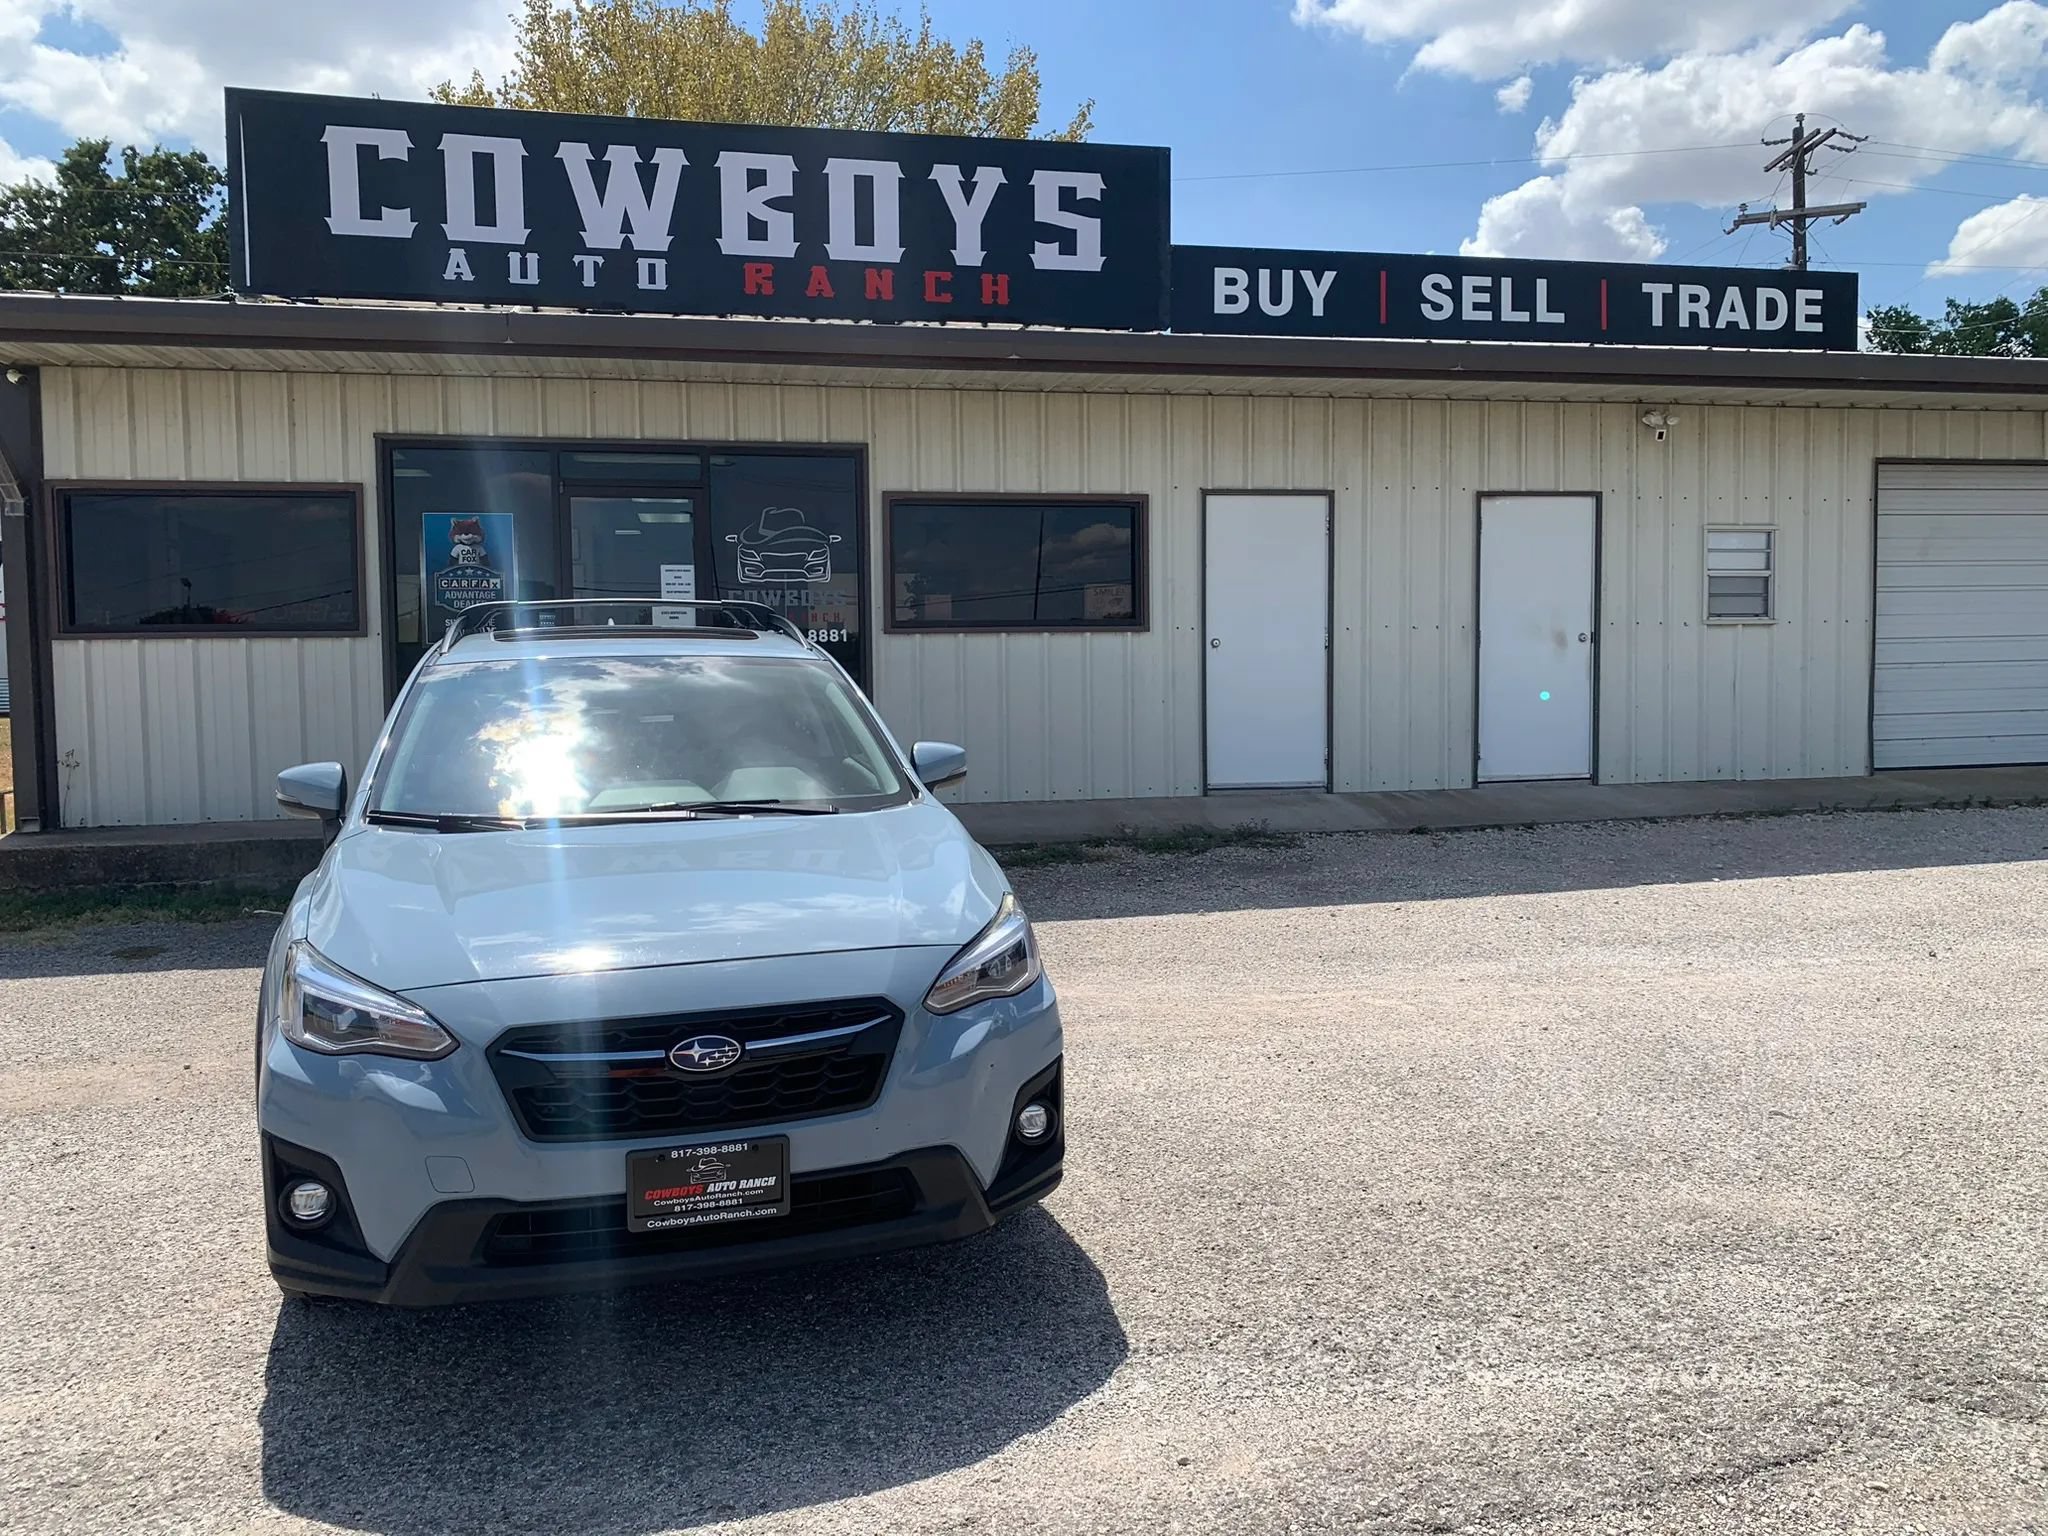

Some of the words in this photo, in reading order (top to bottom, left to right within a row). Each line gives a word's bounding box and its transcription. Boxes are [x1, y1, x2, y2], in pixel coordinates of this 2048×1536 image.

[320, 125, 1107, 273] COWBOYS
[441, 247, 668, 291] AUTO
[744, 261, 1010, 306] RANCH
[1213, 267, 1337, 318] BUY
[1420, 273, 1565, 324] SELL
[1642, 282, 1824, 334] TRADE
[441, 580, 499, 589] CARFAX
[444, 590, 497, 600] ADVANTAGE
[671, 1142, 748, 1159] 817-398-8881
[644, 1184, 705, 1200] COWBOYS
[707, 1180, 737, 1194] AUTO
[739, 1176, 777, 1189] RANCH
[653, 1188, 764, 1207] CowboysAutoRanch.com
[674, 1198, 743, 1213] 817-398-8881
[647, 1207, 777, 1228] CowboysAutoRanch.com
